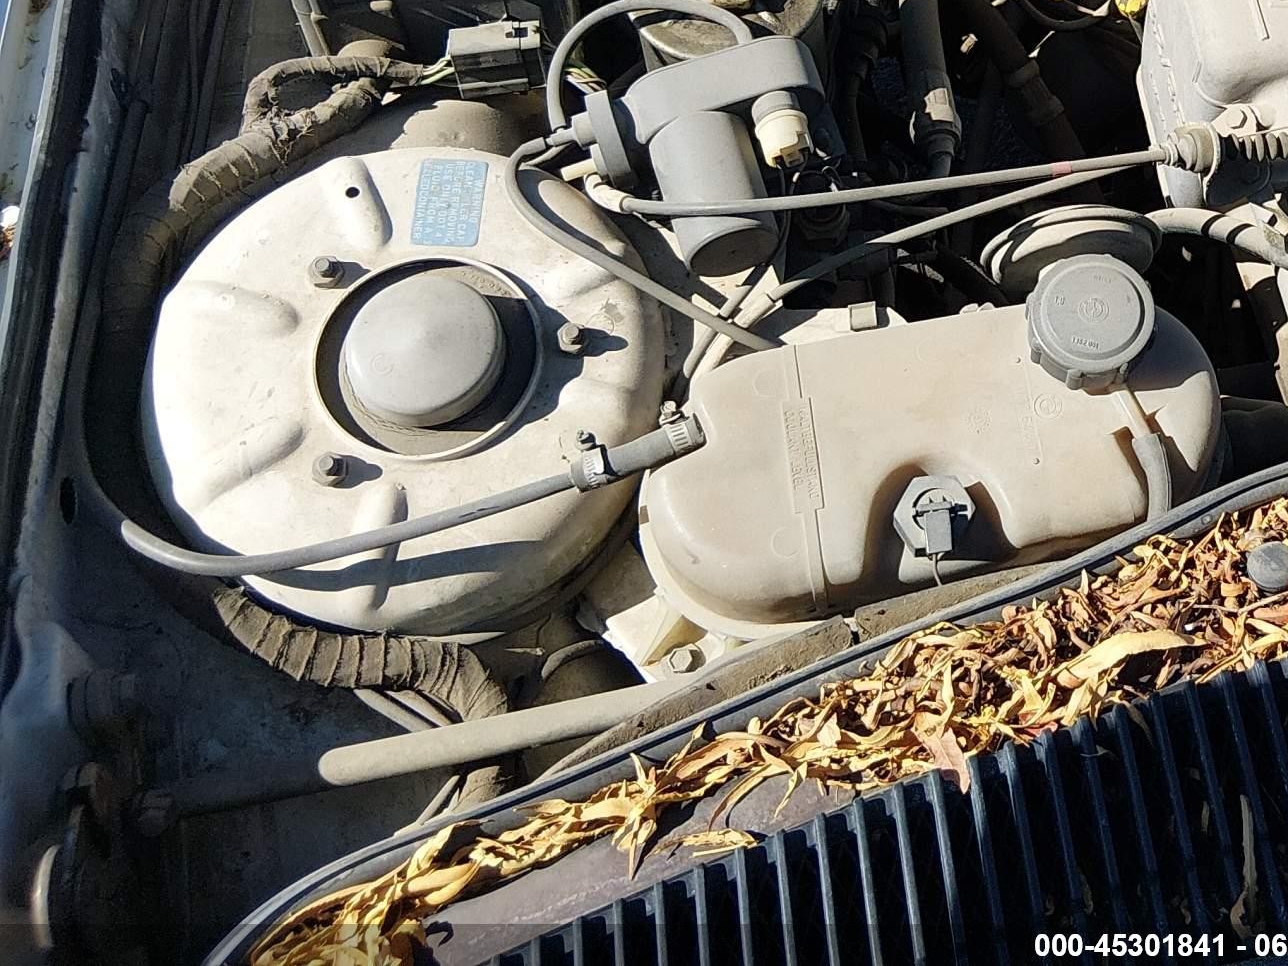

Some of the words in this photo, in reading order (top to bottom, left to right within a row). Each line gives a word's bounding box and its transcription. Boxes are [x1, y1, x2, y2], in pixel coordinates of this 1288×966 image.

[444, 163, 453, 182] USE
[439, 185, 449, 209] ONLY
[469, 178, 484, 223] WARNING
[413, 190, 428, 239] CONTAINER
[437, 209, 447, 228] DOT
